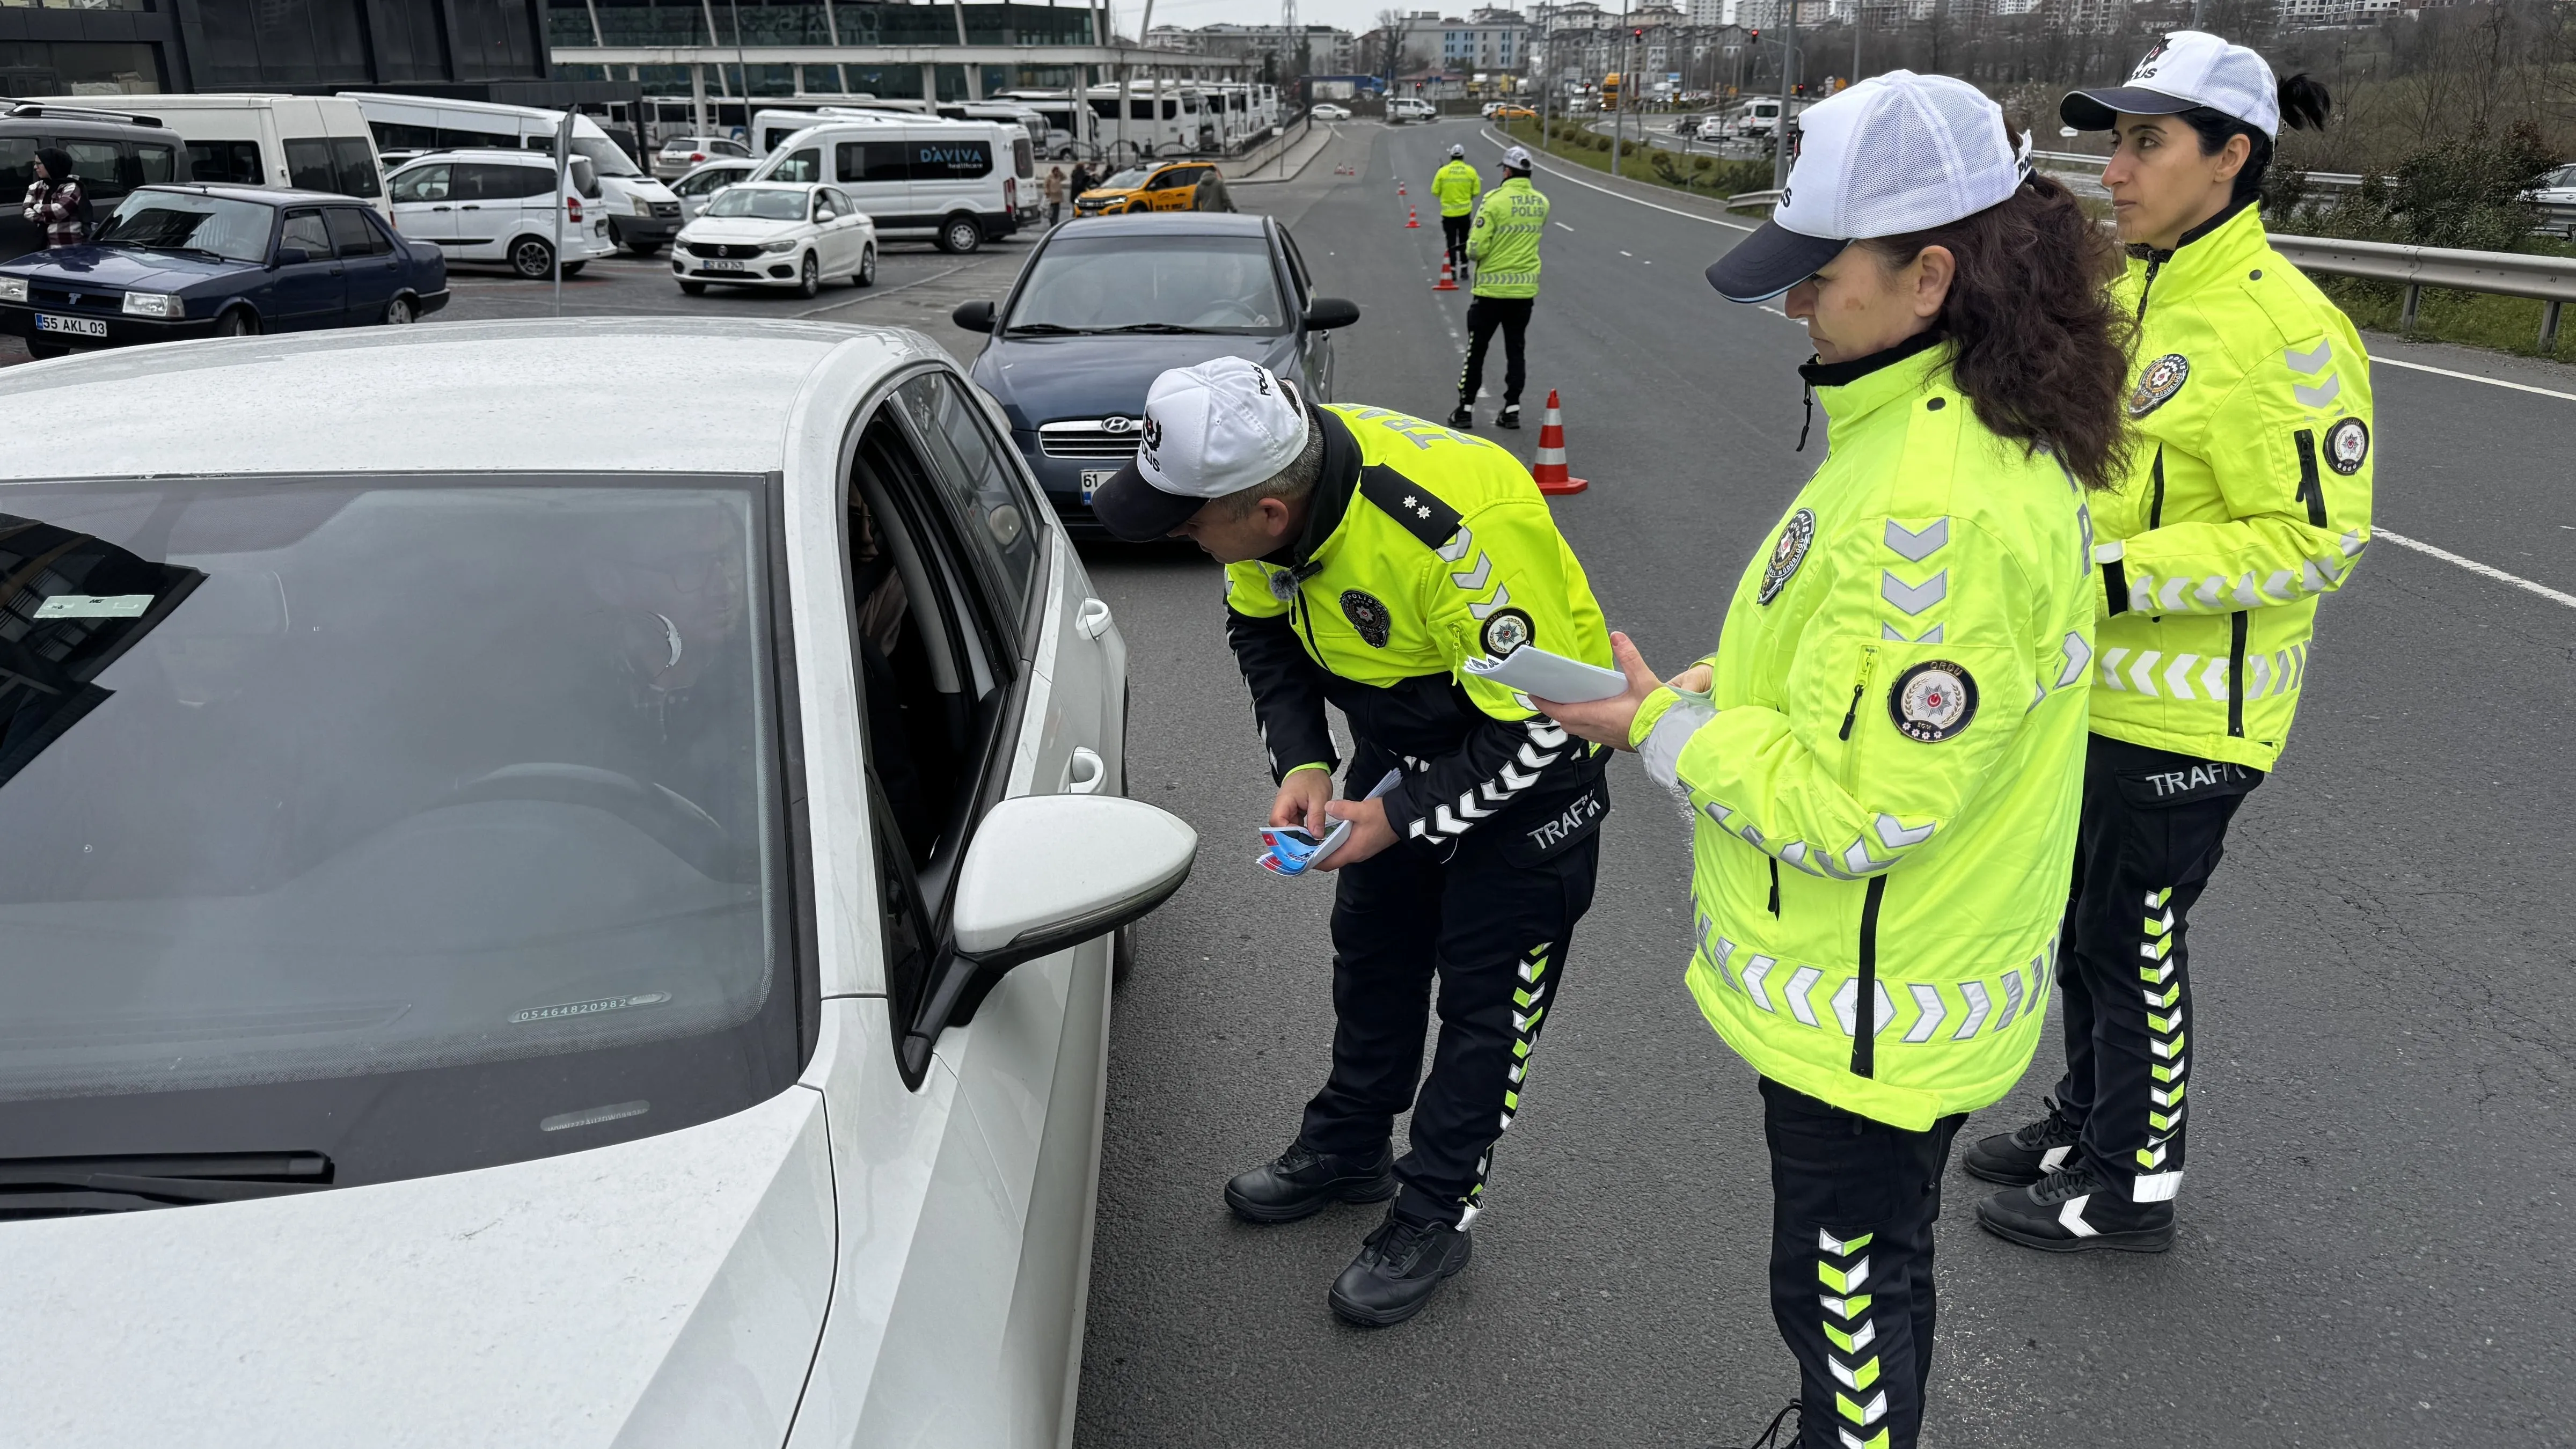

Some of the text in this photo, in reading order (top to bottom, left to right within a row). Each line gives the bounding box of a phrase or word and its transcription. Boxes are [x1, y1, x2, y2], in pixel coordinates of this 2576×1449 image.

[43, 317, 105, 334] 55 AKL 03
[1084, 473, 1098, 488] 61
[1486, 611, 1503, 626] ORDU
[1930, 662, 1963, 677] ORDU
[521, 998, 627, 1020] 05464820982
